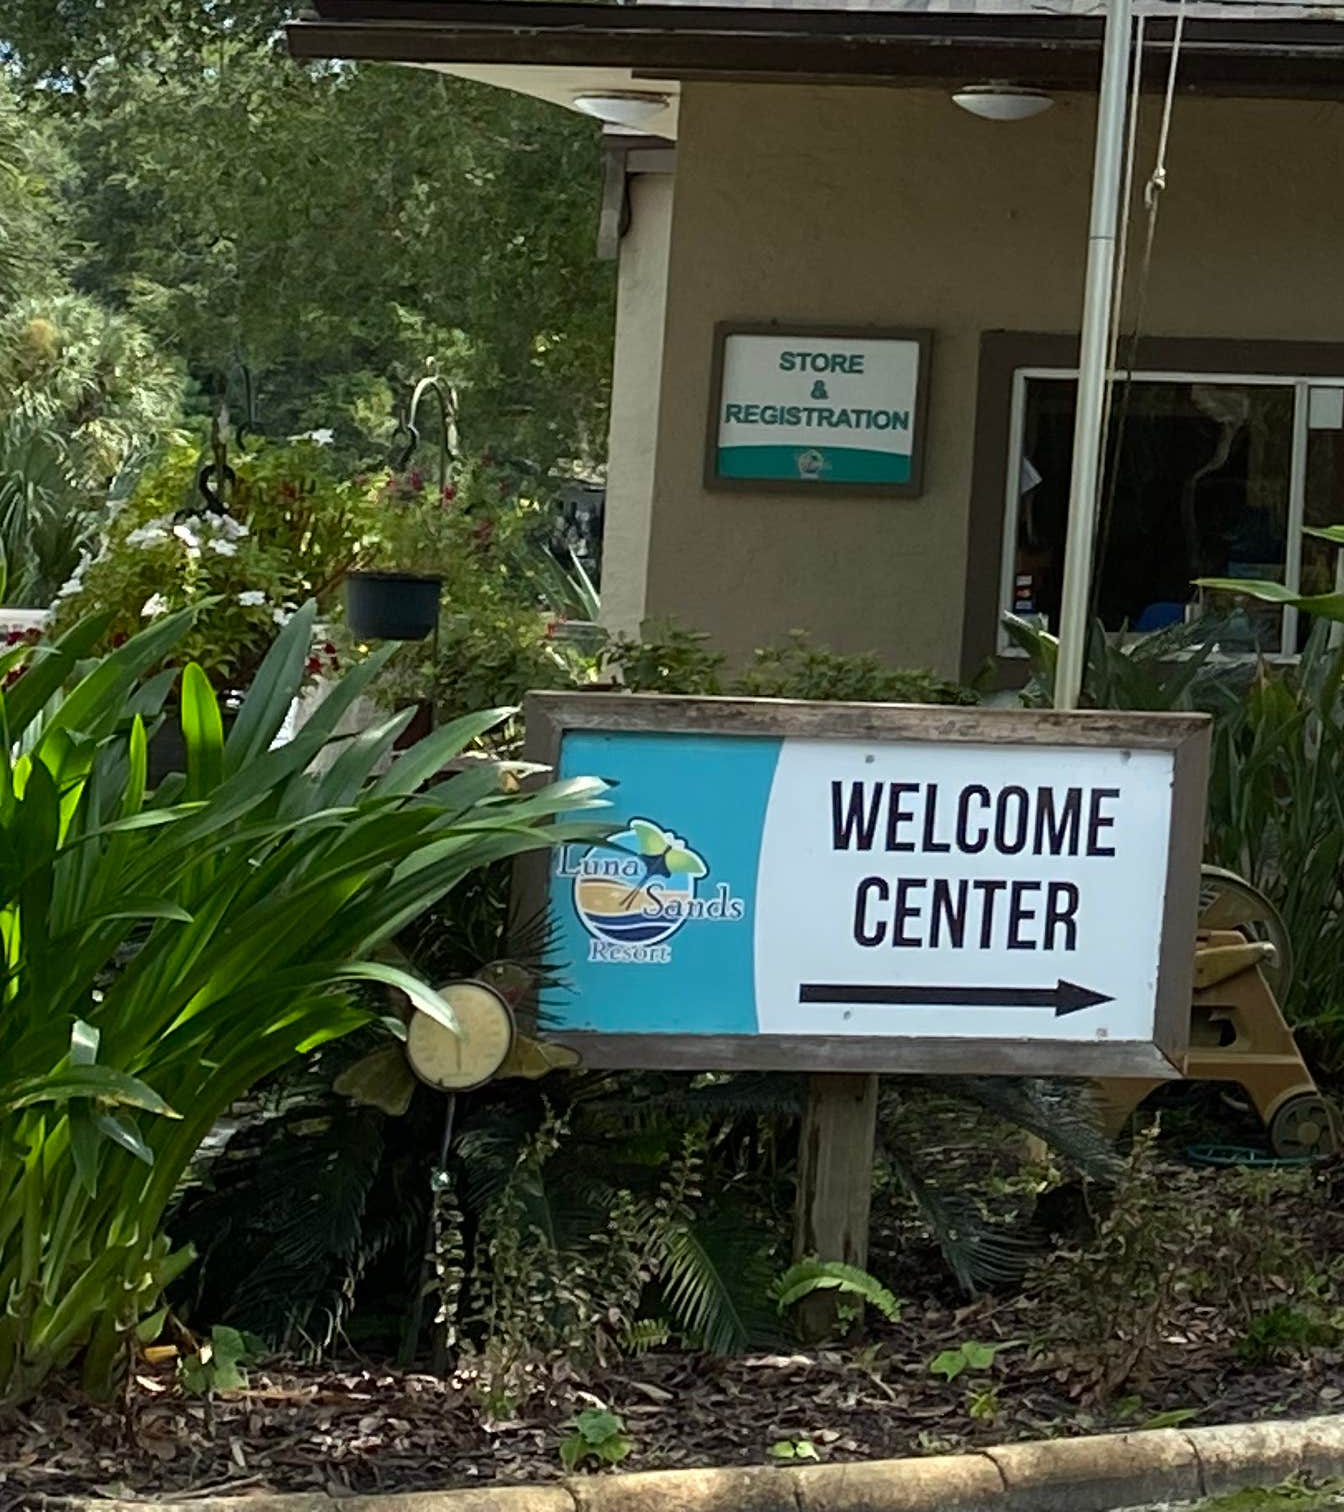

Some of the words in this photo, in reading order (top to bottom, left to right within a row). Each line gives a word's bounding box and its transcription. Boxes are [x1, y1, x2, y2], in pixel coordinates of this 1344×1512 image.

[779, 351, 865, 374] STORE
[810, 379, 829, 400] &
[724, 403, 910, 430] REGISTRATION
[830, 781, 1121, 858] WELCOME
[558, 843, 642, 877] Luna
[643, 882, 744, 920] Sands
[852, 877, 1081, 951] CENTER
[590, 940, 671, 963] Resort
